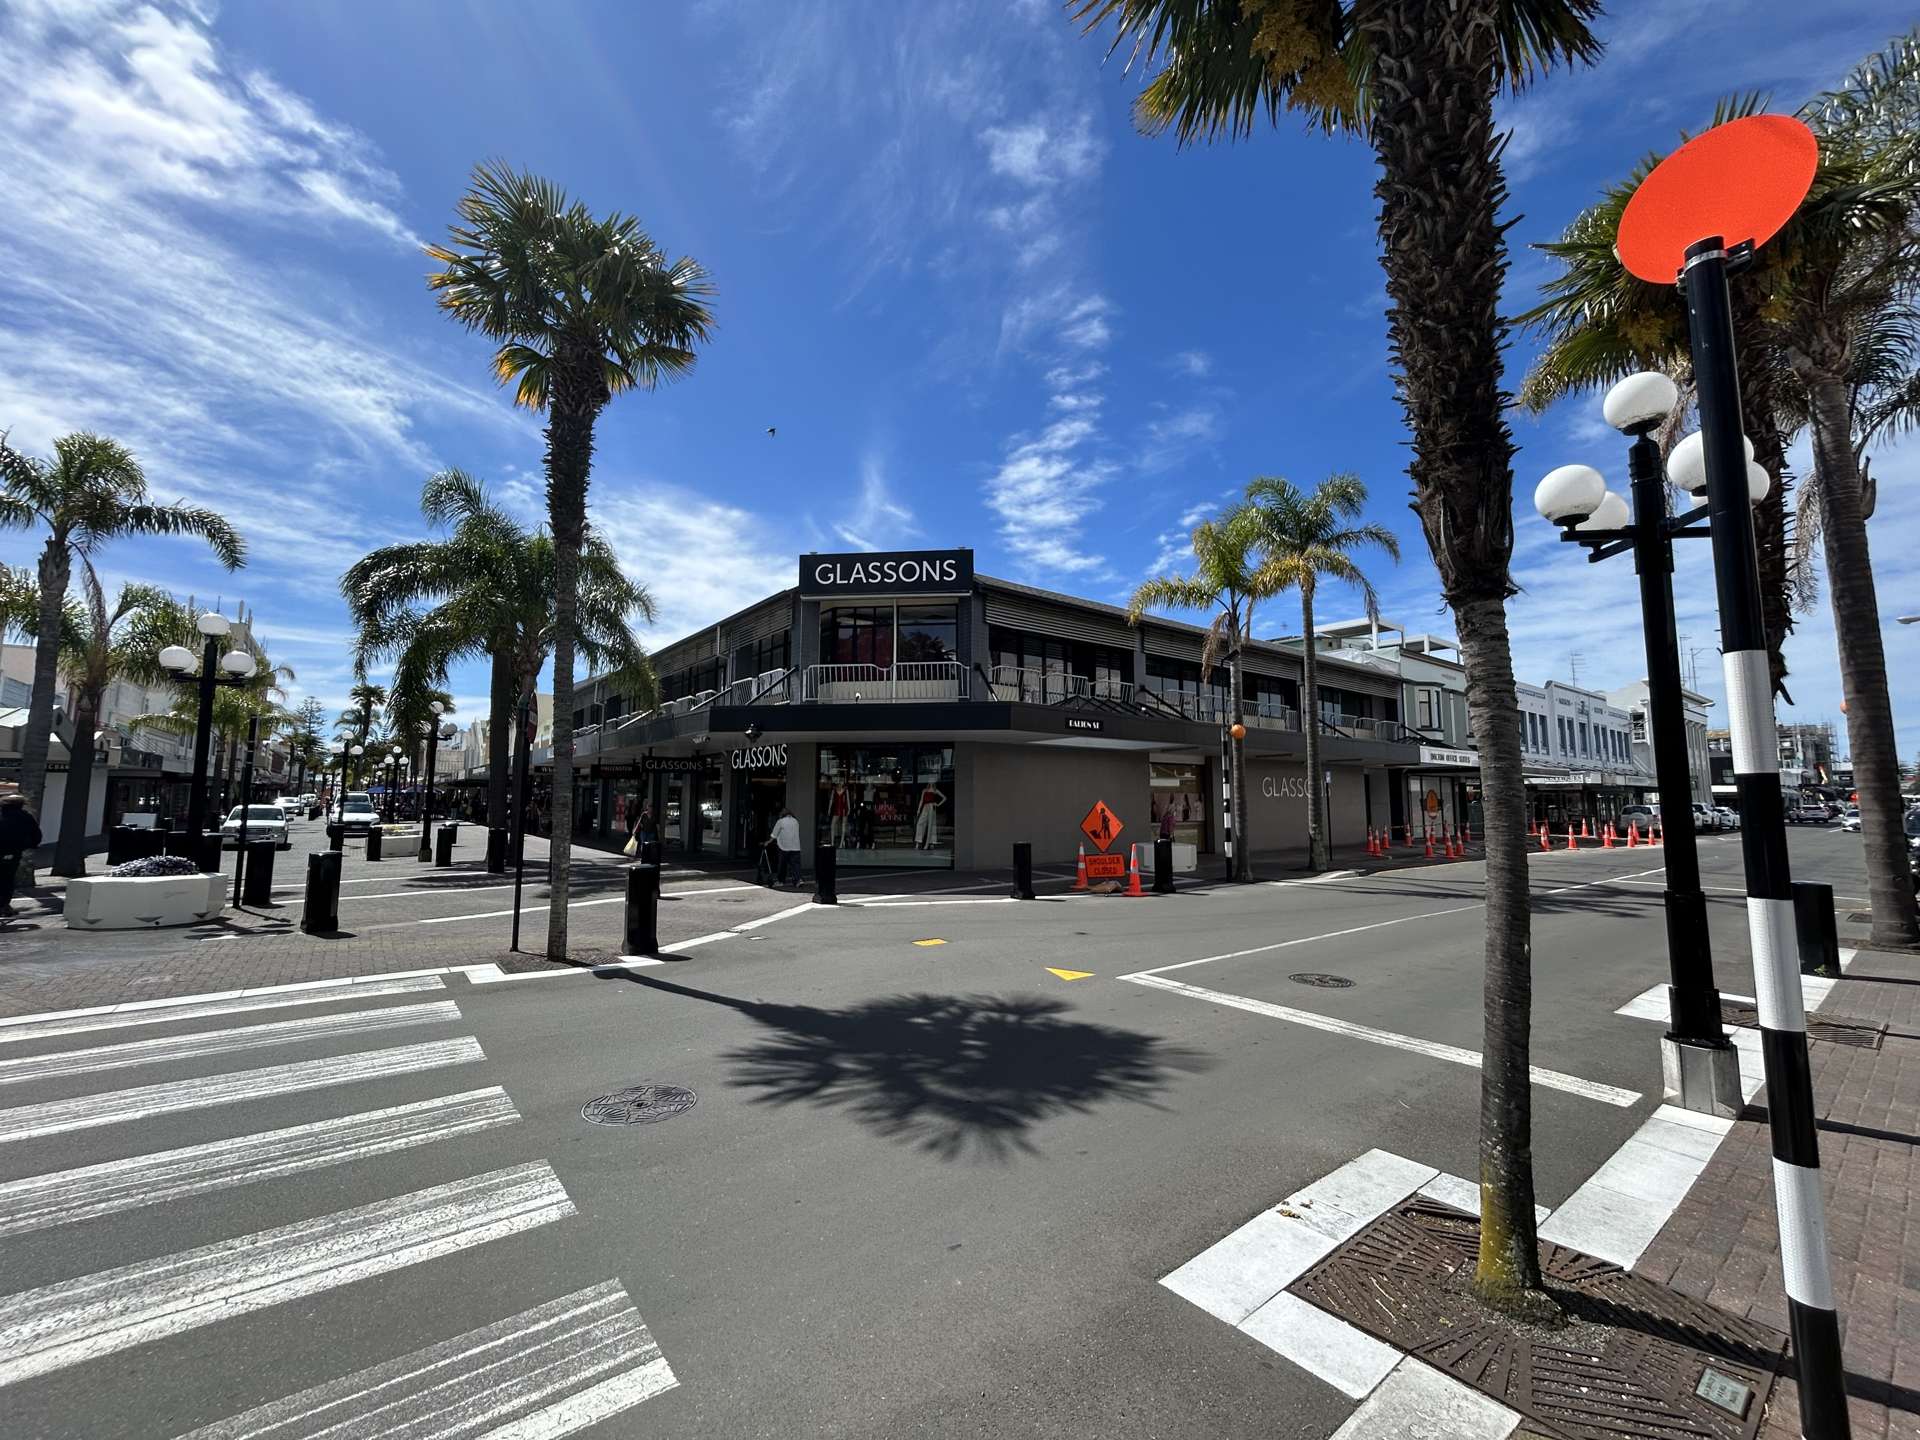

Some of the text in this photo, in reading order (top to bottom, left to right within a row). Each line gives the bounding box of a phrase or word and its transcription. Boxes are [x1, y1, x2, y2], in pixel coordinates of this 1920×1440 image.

[815, 559, 957, 585] GLASSONS
[645, 758, 704, 771] GLASSONS
[731, 743, 788, 770] GLASSONS
[1093, 866, 1118, 875] CLOSED
